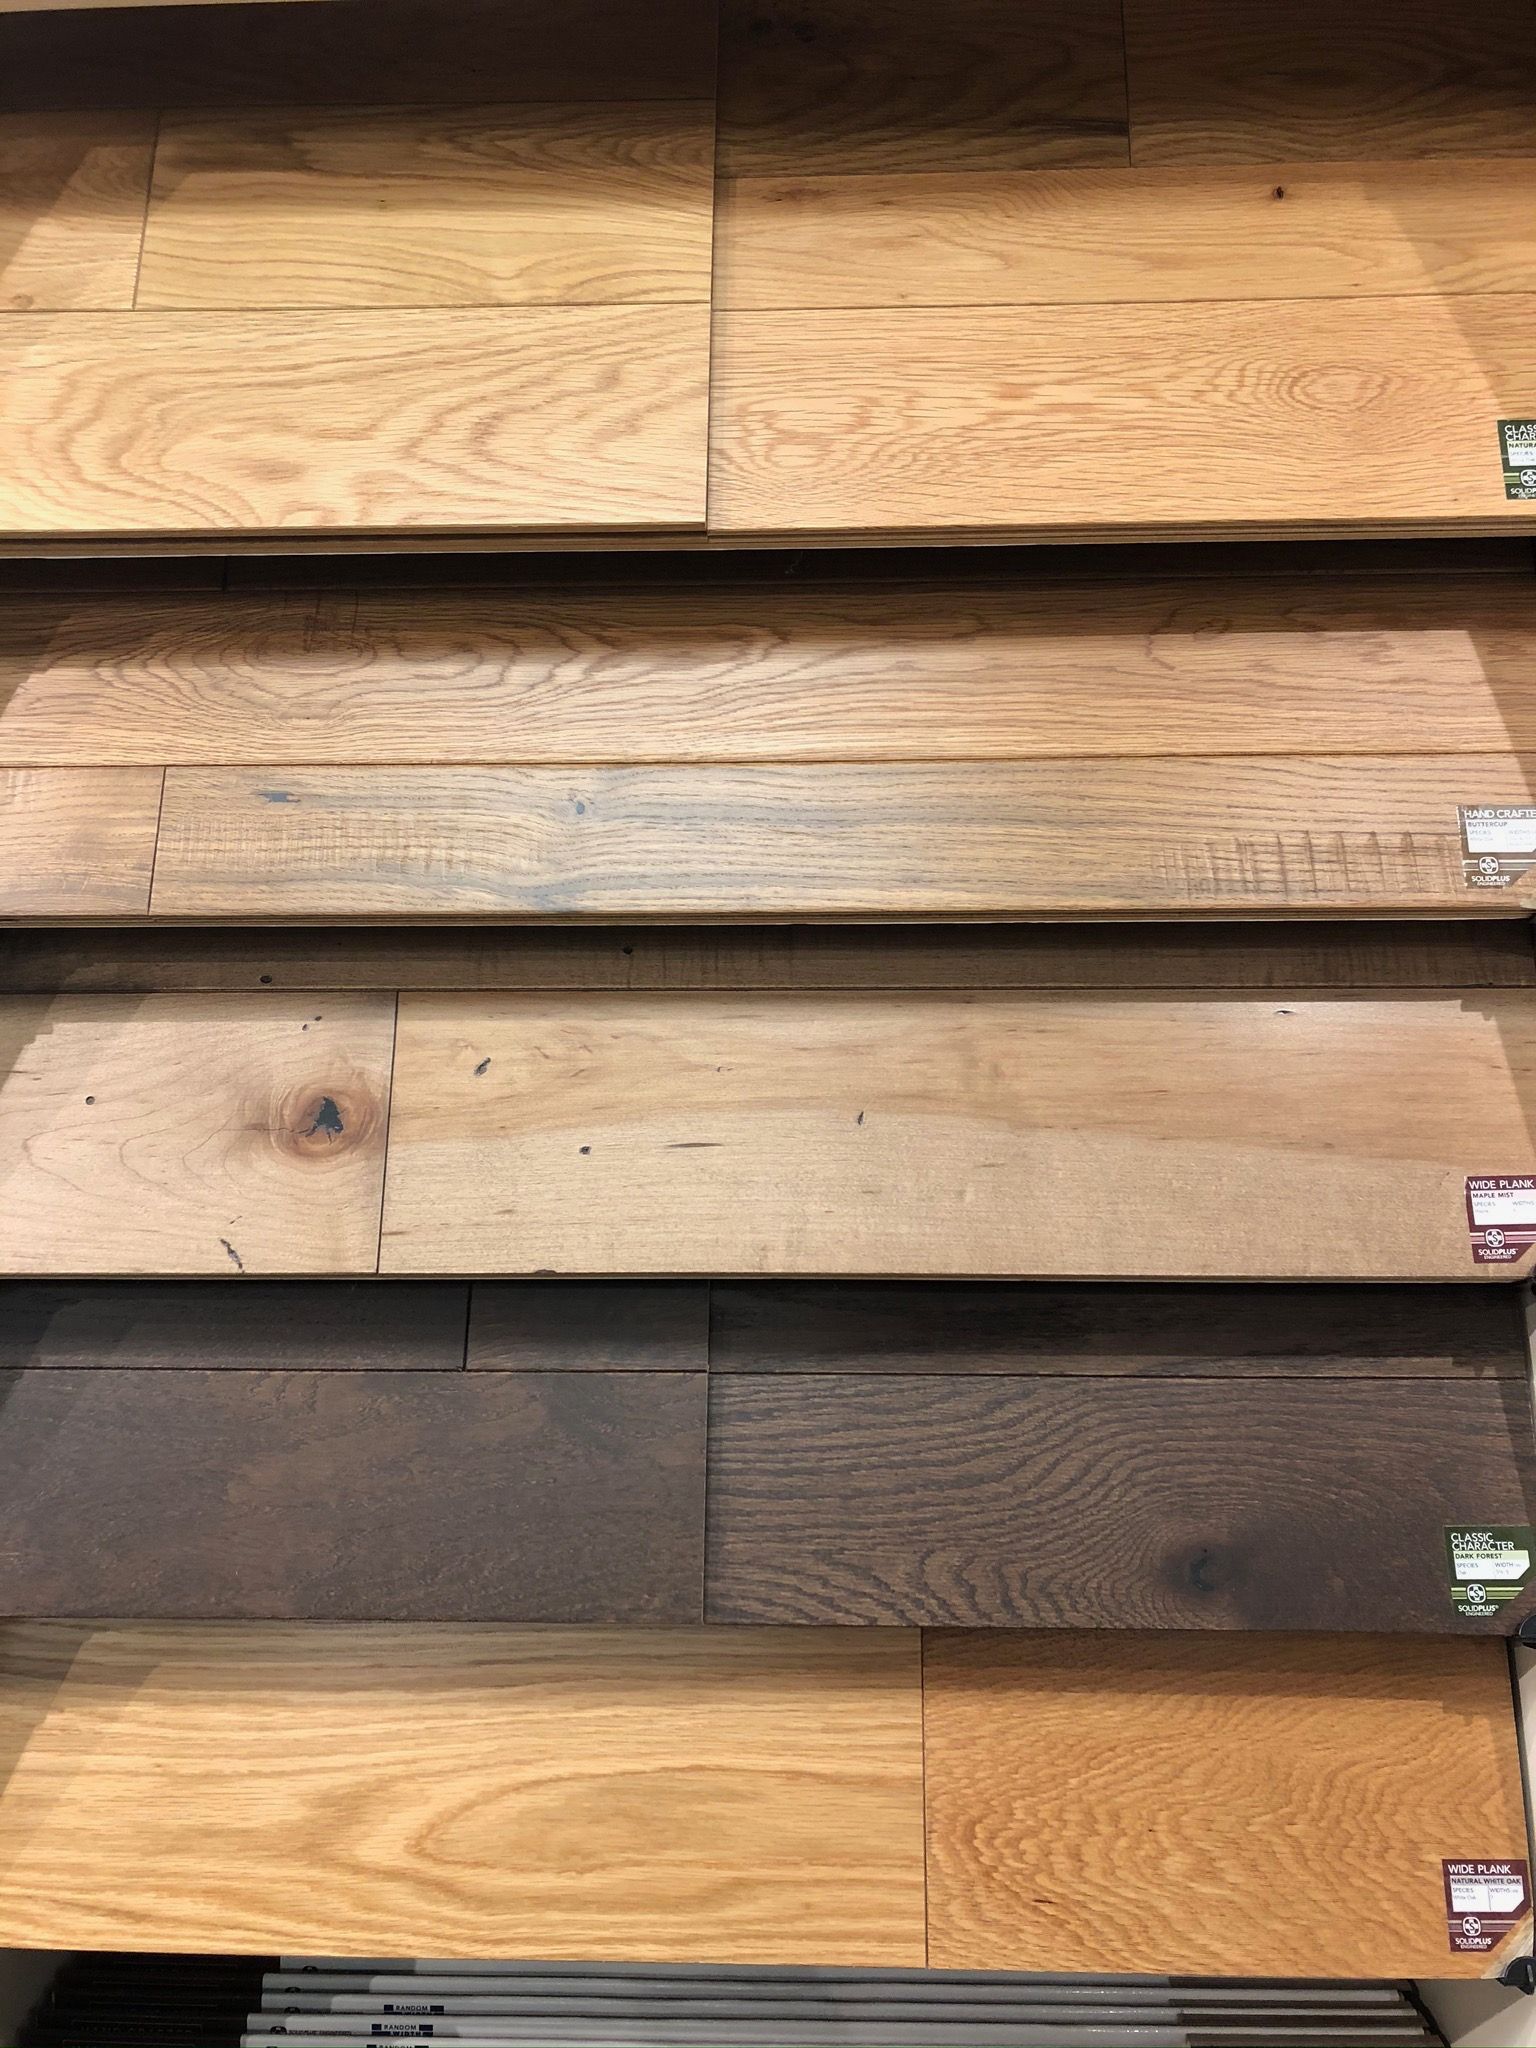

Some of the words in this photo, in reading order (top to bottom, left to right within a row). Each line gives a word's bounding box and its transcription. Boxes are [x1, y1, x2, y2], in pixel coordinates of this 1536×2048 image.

[1505, 433, 1536, 441] CHAR
[1464, 809, 1495, 818] HAND
[1468, 1180, 1496, 1189] WIDE
[1499, 1179, 1535, 1188] PLANK
[1450, 1532, 1494, 1542] CLASSIC
[1451, 1541, 1515, 1550] CHARACTER
[1447, 1864, 1475, 1874] WIDE
[1477, 1864, 1511, 1874] PLANK
